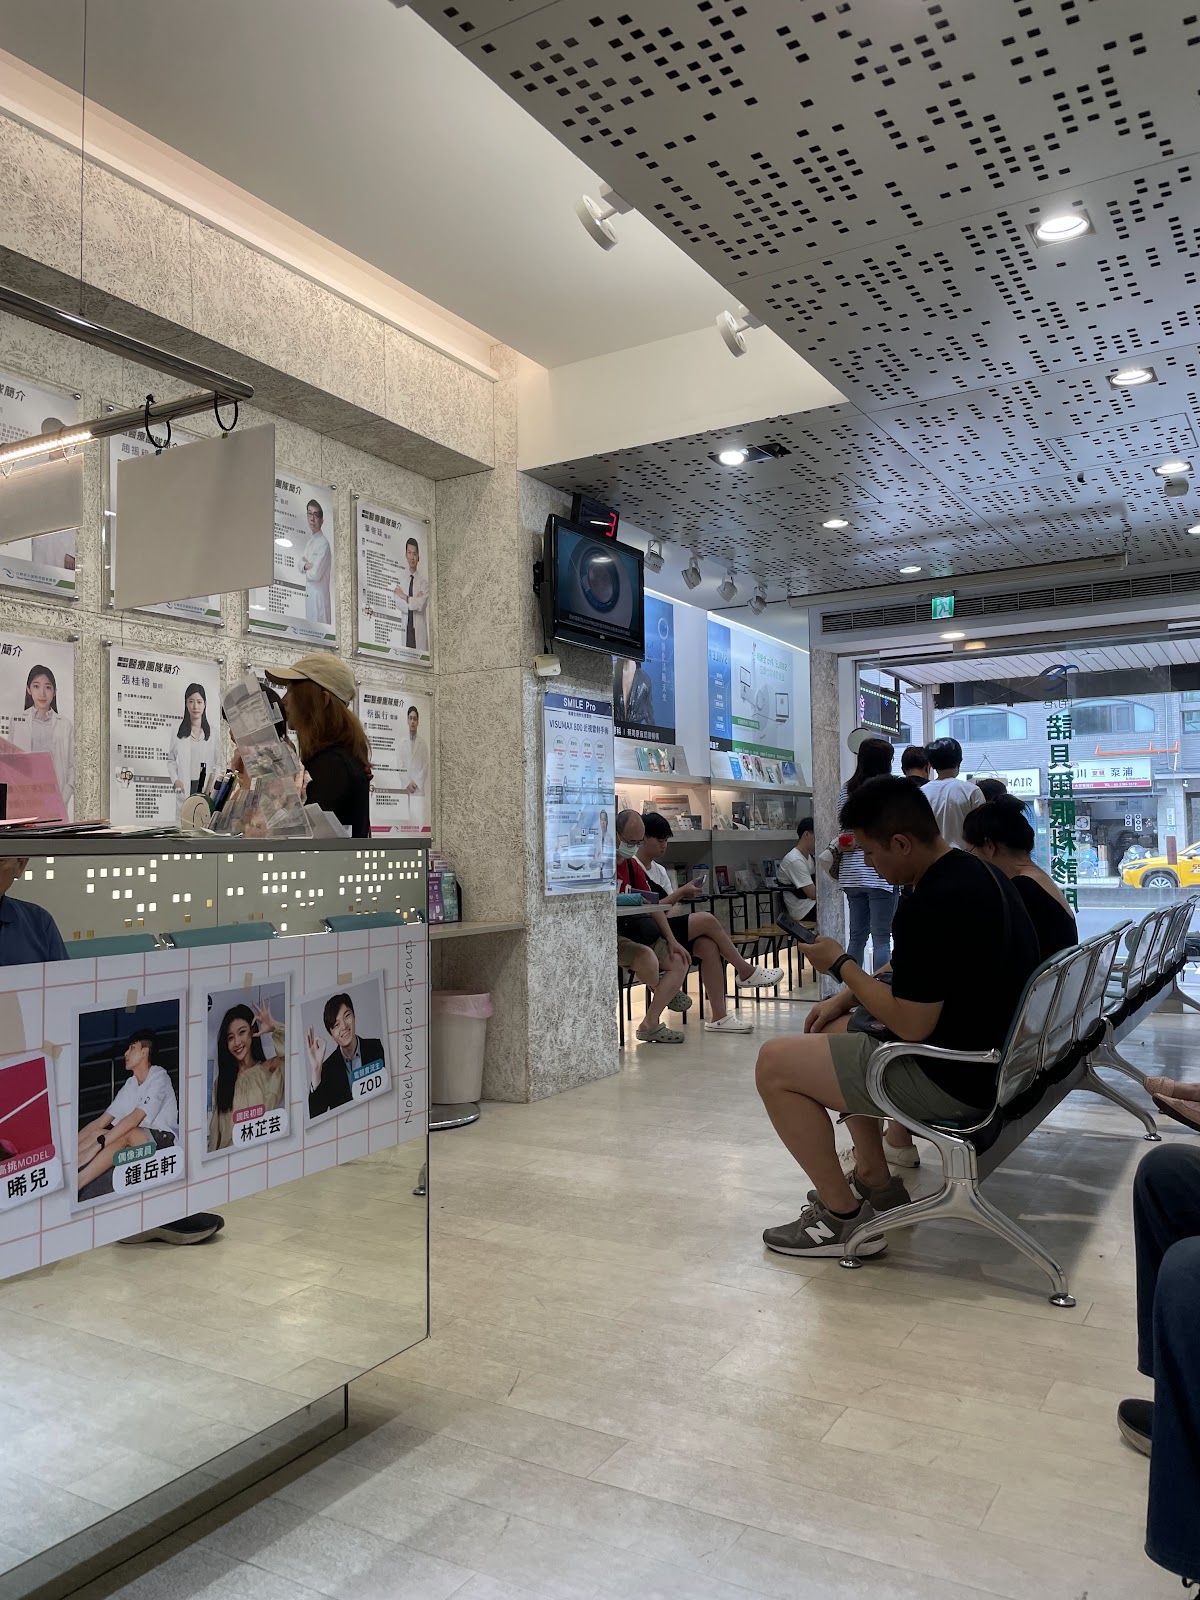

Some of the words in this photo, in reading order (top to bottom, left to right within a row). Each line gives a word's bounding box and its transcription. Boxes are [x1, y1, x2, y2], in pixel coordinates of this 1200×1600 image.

[128, 658, 181, 676] 醫療團隊簡介
[563, 697, 583, 710] SMILE
[585, 701, 596, 712] Pro
[1008, 777, 1033, 787] HAIR
[404, 939, 417, 993] Group
[402, 998, 414, 1069] Medical
[359, 1075, 382, 1096] ZOD
[403, 1074, 414, 1125] Nobel
[240, 1115, 281, 1143] 林芷芸
[118, 1145, 152, 1163] 偶像演員
